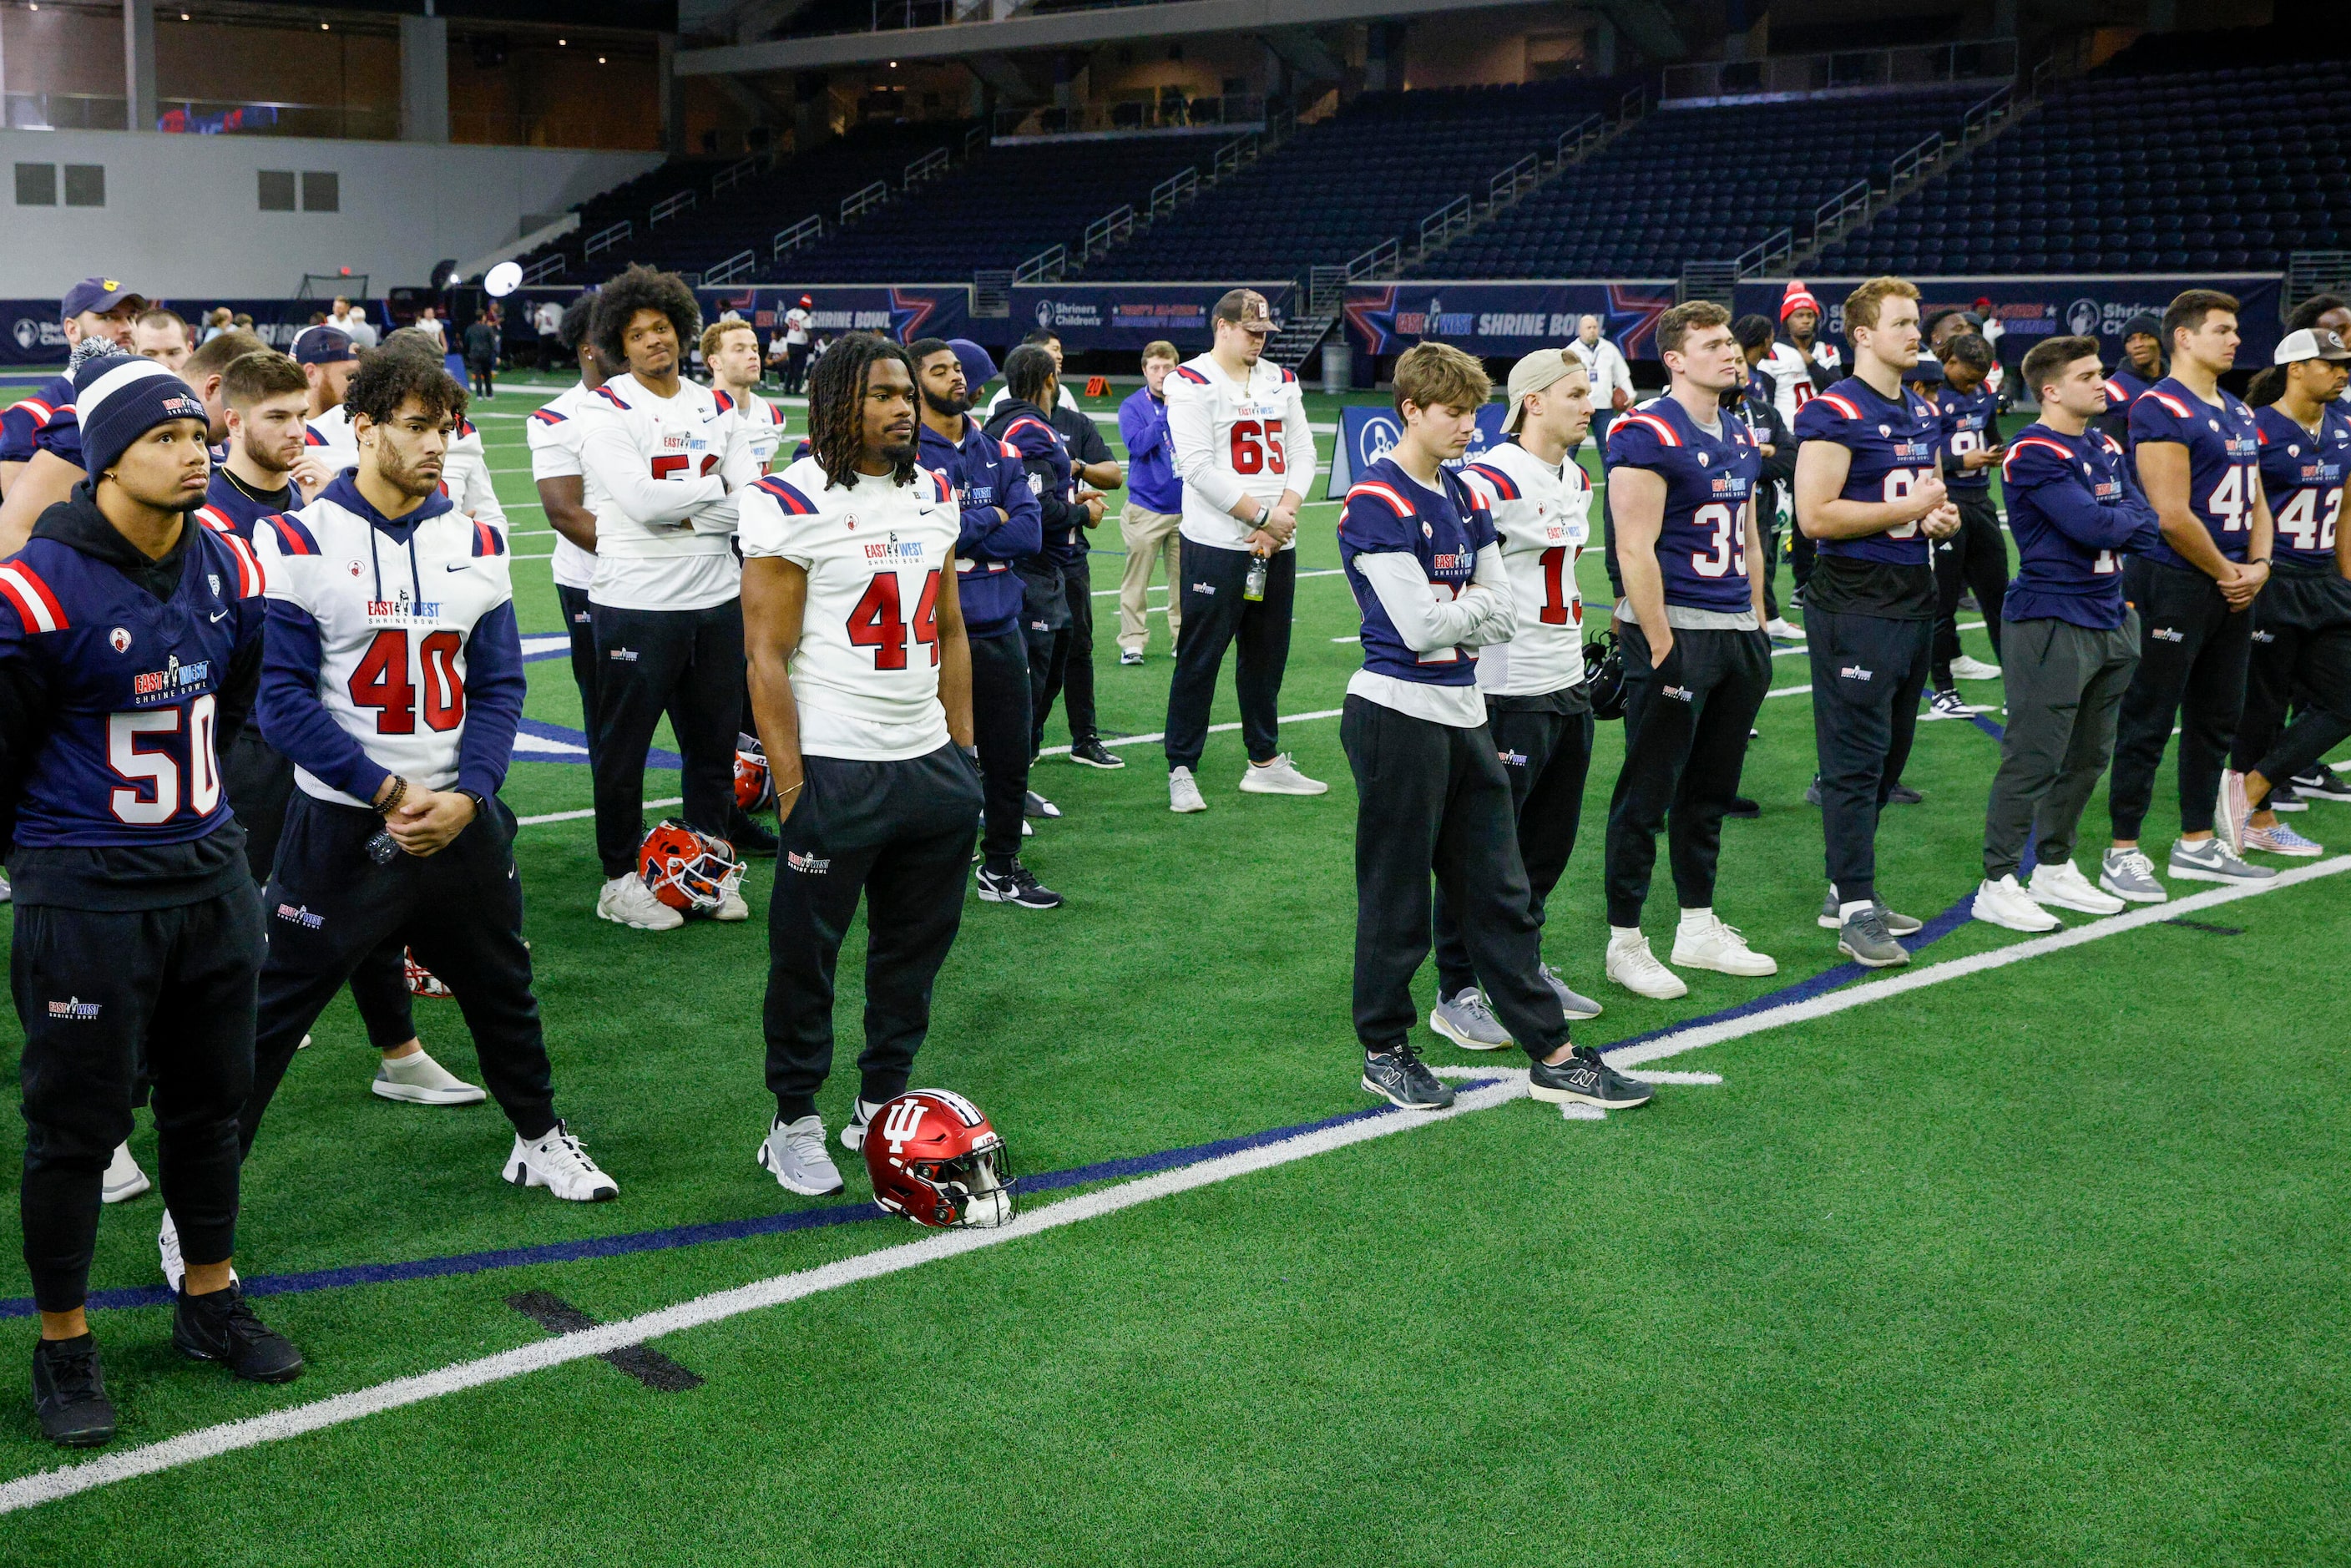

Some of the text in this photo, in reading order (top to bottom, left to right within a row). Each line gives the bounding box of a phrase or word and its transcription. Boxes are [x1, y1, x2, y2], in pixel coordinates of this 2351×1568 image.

[1055, 303, 1096, 315] Shriners
[854, 311, 891, 328] BOWL
[1396, 312, 1605, 336] EAST WEST SHRINE BOL
[1087, 378, 1100, 393] 20
[665, 437, 706, 450] EAST WEST
[1231, 420, 1285, 474] 65
[972, 486, 992, 500] WEST
[2276, 487, 2343, 549] 42
[1546, 527, 1561, 540] EAST
[865, 542, 923, 559] EAST WEST
[1434, 554, 1455, 569] EAST
[1539, 546, 1584, 625] 1
[367, 600, 440, 618] EAST WEST
[846, 569, 941, 670] 44
[134, 660, 209, 695] EAST WEST
[347, 629, 464, 735] 40
[135, 680, 207, 705] SHRINE BOWL
[106, 692, 220, 825] 50
[810, 859, 831, 869] WEST
[48, 1000, 99, 1016] EAST WEST
